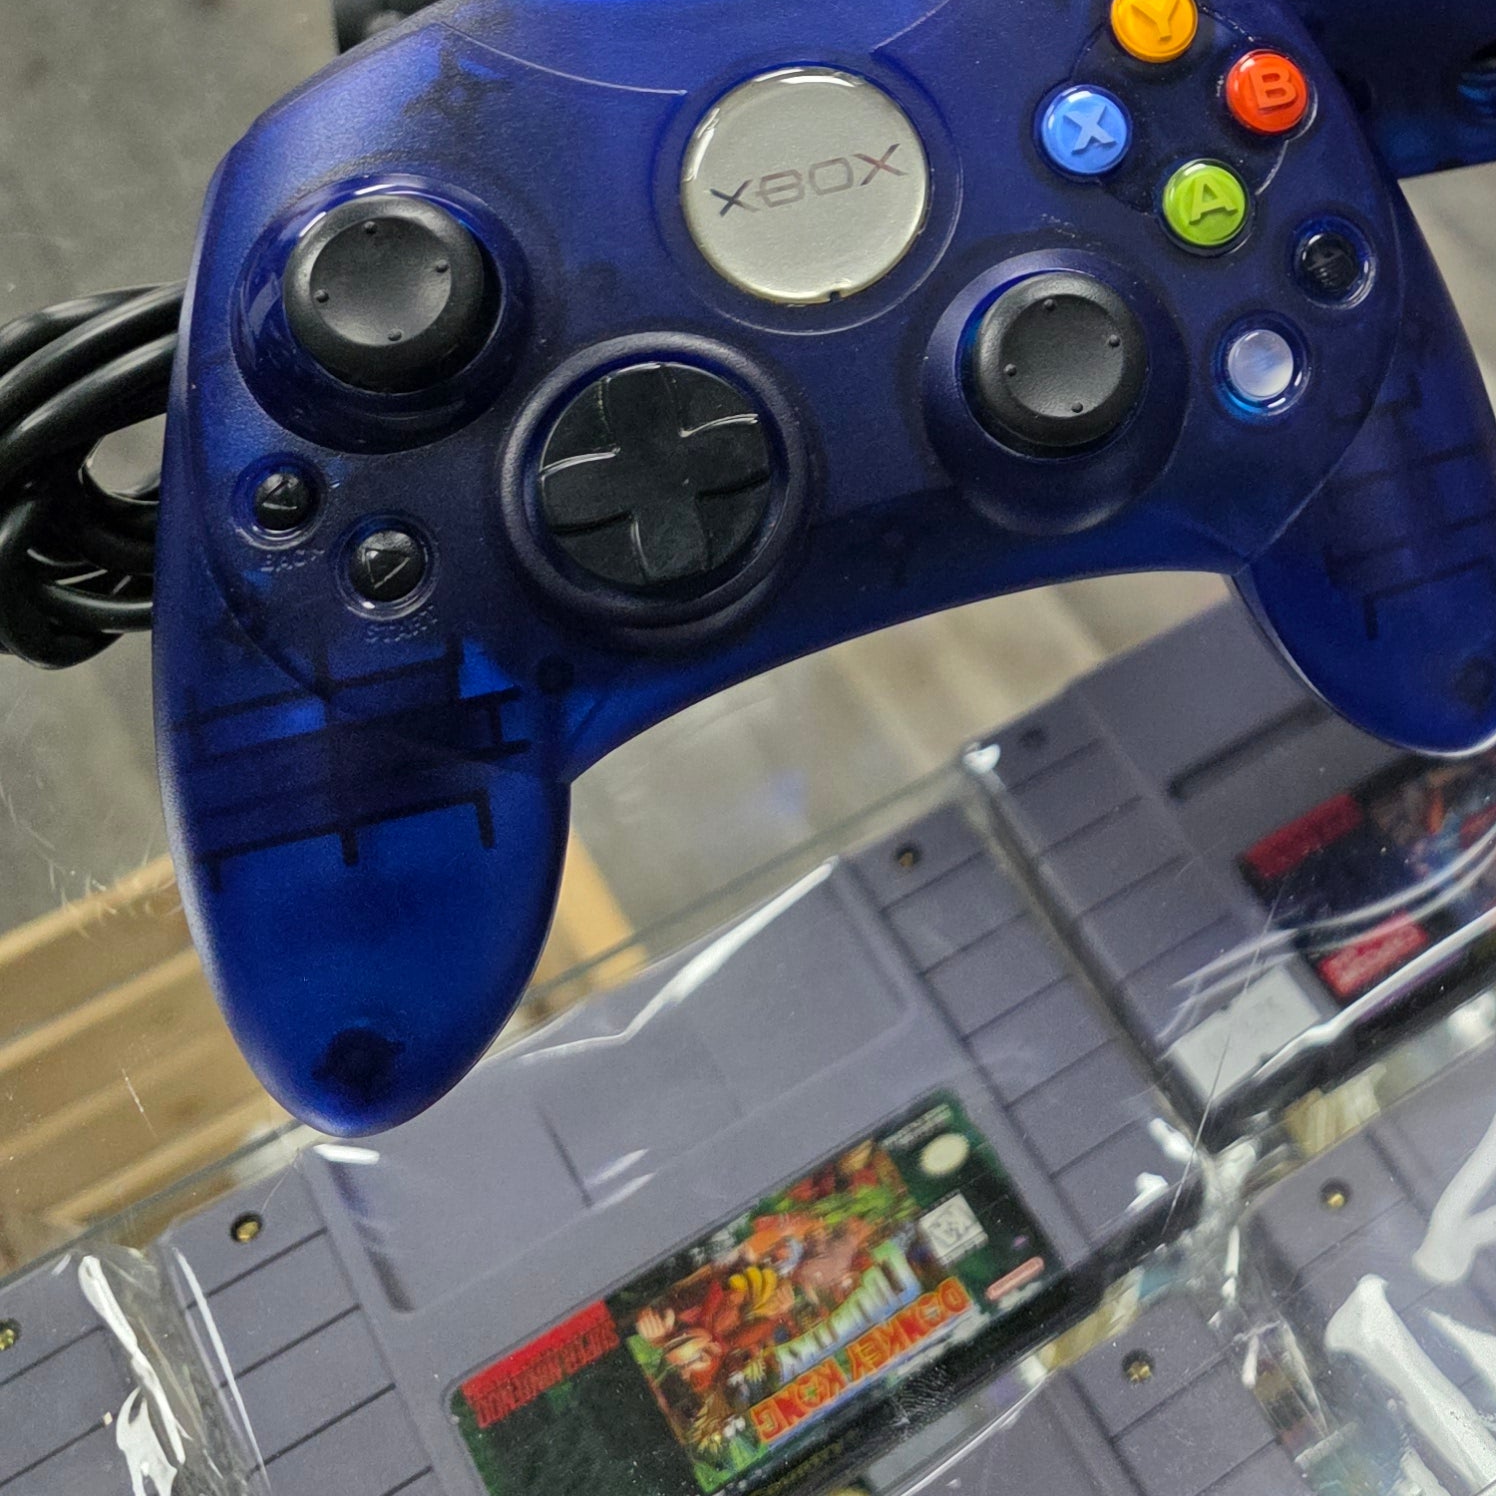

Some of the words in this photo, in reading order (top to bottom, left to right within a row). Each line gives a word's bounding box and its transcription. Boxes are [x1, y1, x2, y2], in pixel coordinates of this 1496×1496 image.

[1249, 66, 1298, 112] B
[1063, 106, 1116, 155] X
[709, 142, 908, 217] XBOX
[1187, 173, 1239, 226] A
[847, 1276, 973, 1387] DONKEY
[750, 1357, 850, 1442] KONG
